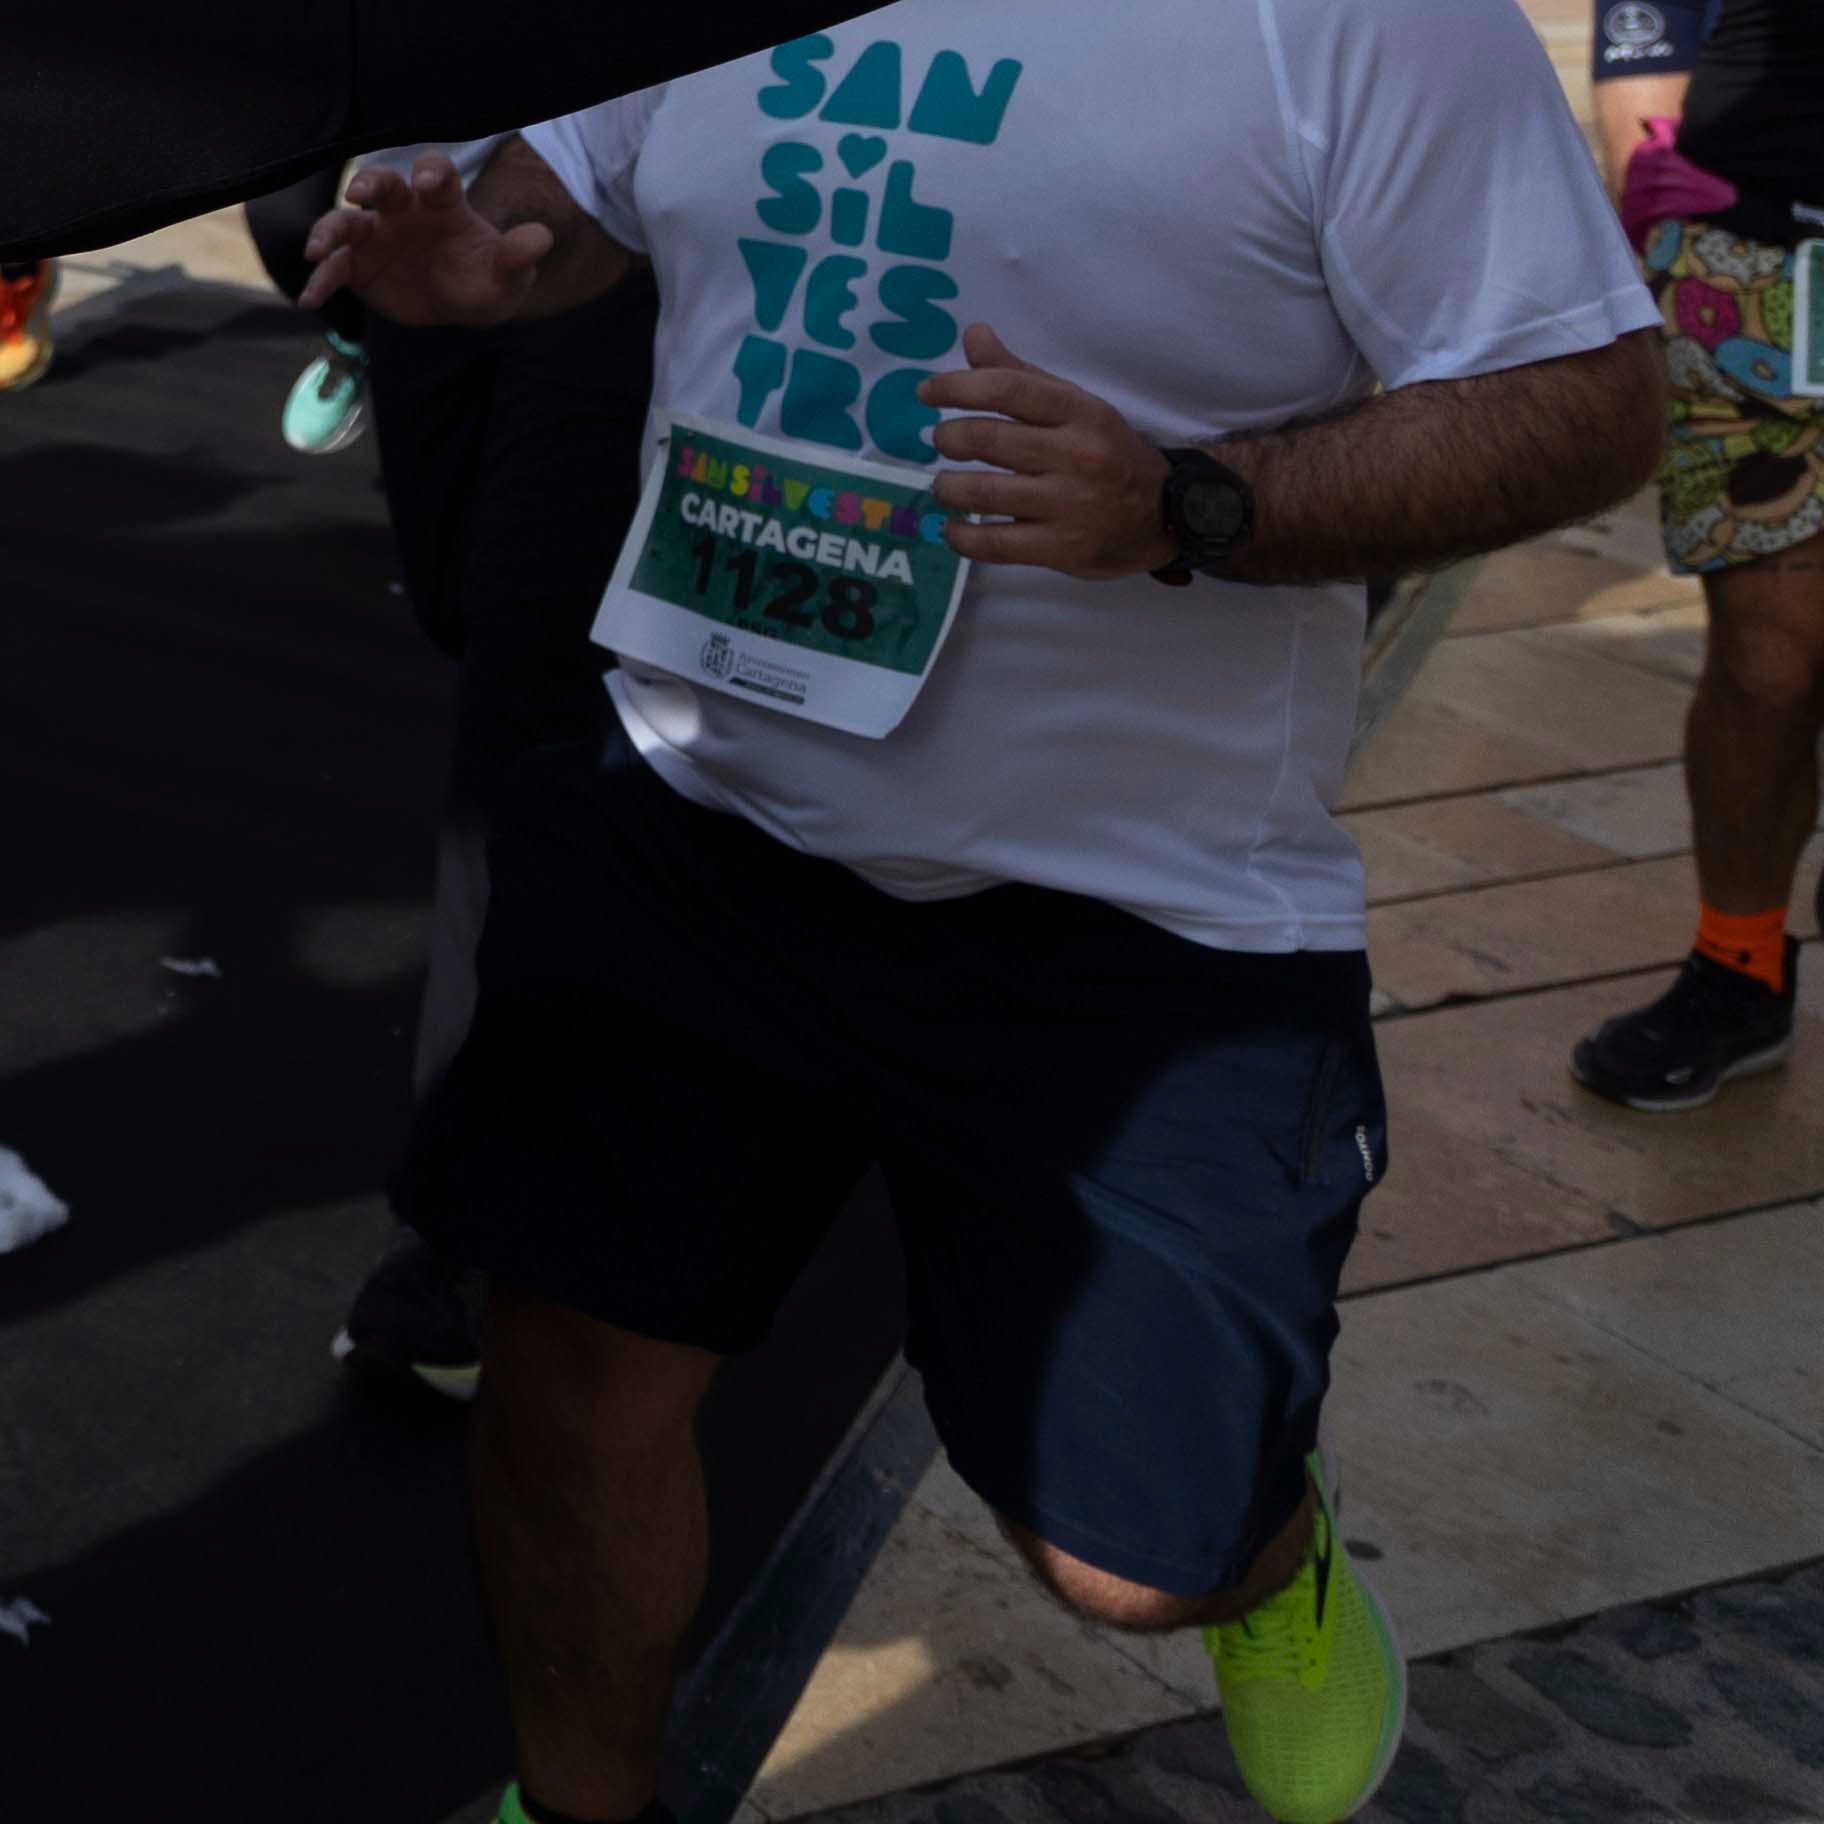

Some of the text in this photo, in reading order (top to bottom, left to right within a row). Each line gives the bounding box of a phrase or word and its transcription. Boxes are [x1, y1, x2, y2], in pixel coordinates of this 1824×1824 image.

[757, 33, 1023, 146] SAN
[737, 237, 959, 360] VES
[733, 332, 943, 464] TRE
[678, 446, 728, 489] SAN
[680, 492, 913, 585] CARTAGENA
[690, 538, 877, 641] 1128
